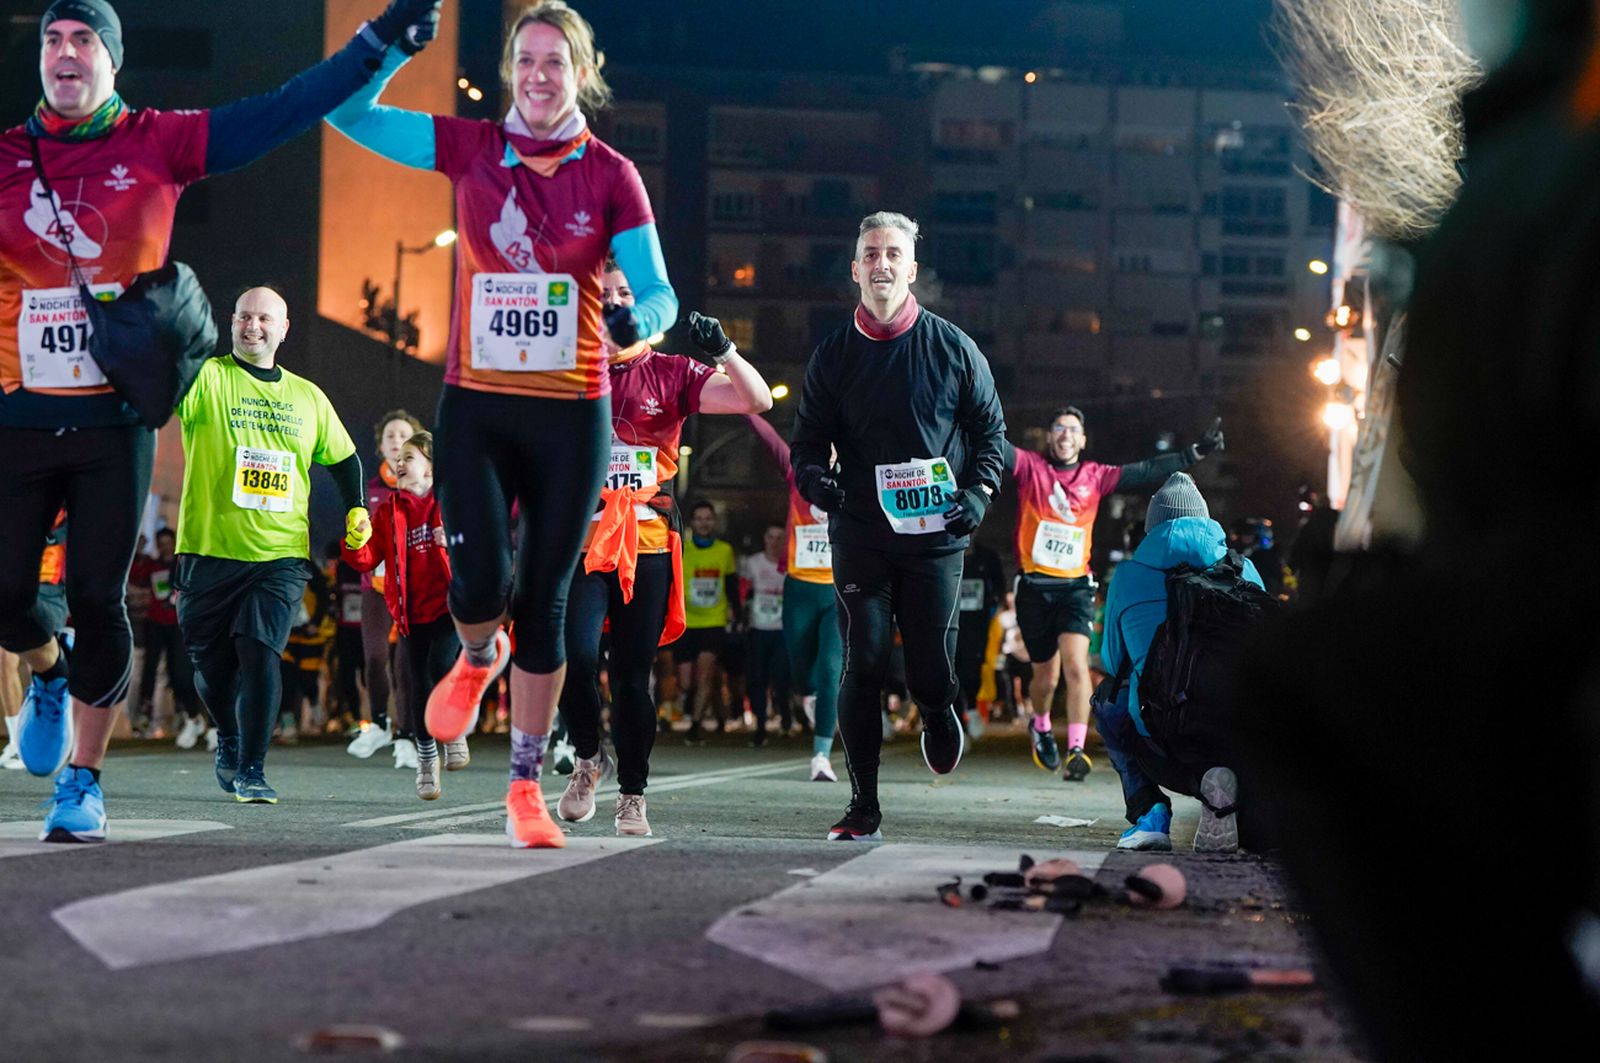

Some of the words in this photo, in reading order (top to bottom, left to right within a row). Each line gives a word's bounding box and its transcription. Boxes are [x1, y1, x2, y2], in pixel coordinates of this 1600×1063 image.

[505, 240, 531, 268] 43
[496, 285, 523, 294] NOCHE
[526, 285, 537, 294] DE
[39, 300, 70, 310] NOCHE
[484, 296, 503, 306] SAN
[29, 313, 49, 324] SAN
[489, 309, 558, 337] 4969
[41, 323, 88, 353] 497
[241, 396, 270, 407] NUNCA
[271, 401, 294, 412] DEJES
[231, 407, 242, 417] DE
[243, 409, 269, 420] HACER
[270, 412, 304, 426] AQUELLO
[620, 454, 630, 462] DE
[242, 469, 288, 491] 13843
[894, 471, 915, 479] NOCHE
[916, 468, 926, 477] DE
[605, 473, 642, 491] 175
[886, 479, 902, 489] SAN
[895, 484, 944, 511] 8078
[1045, 539, 1074, 556] 4728
